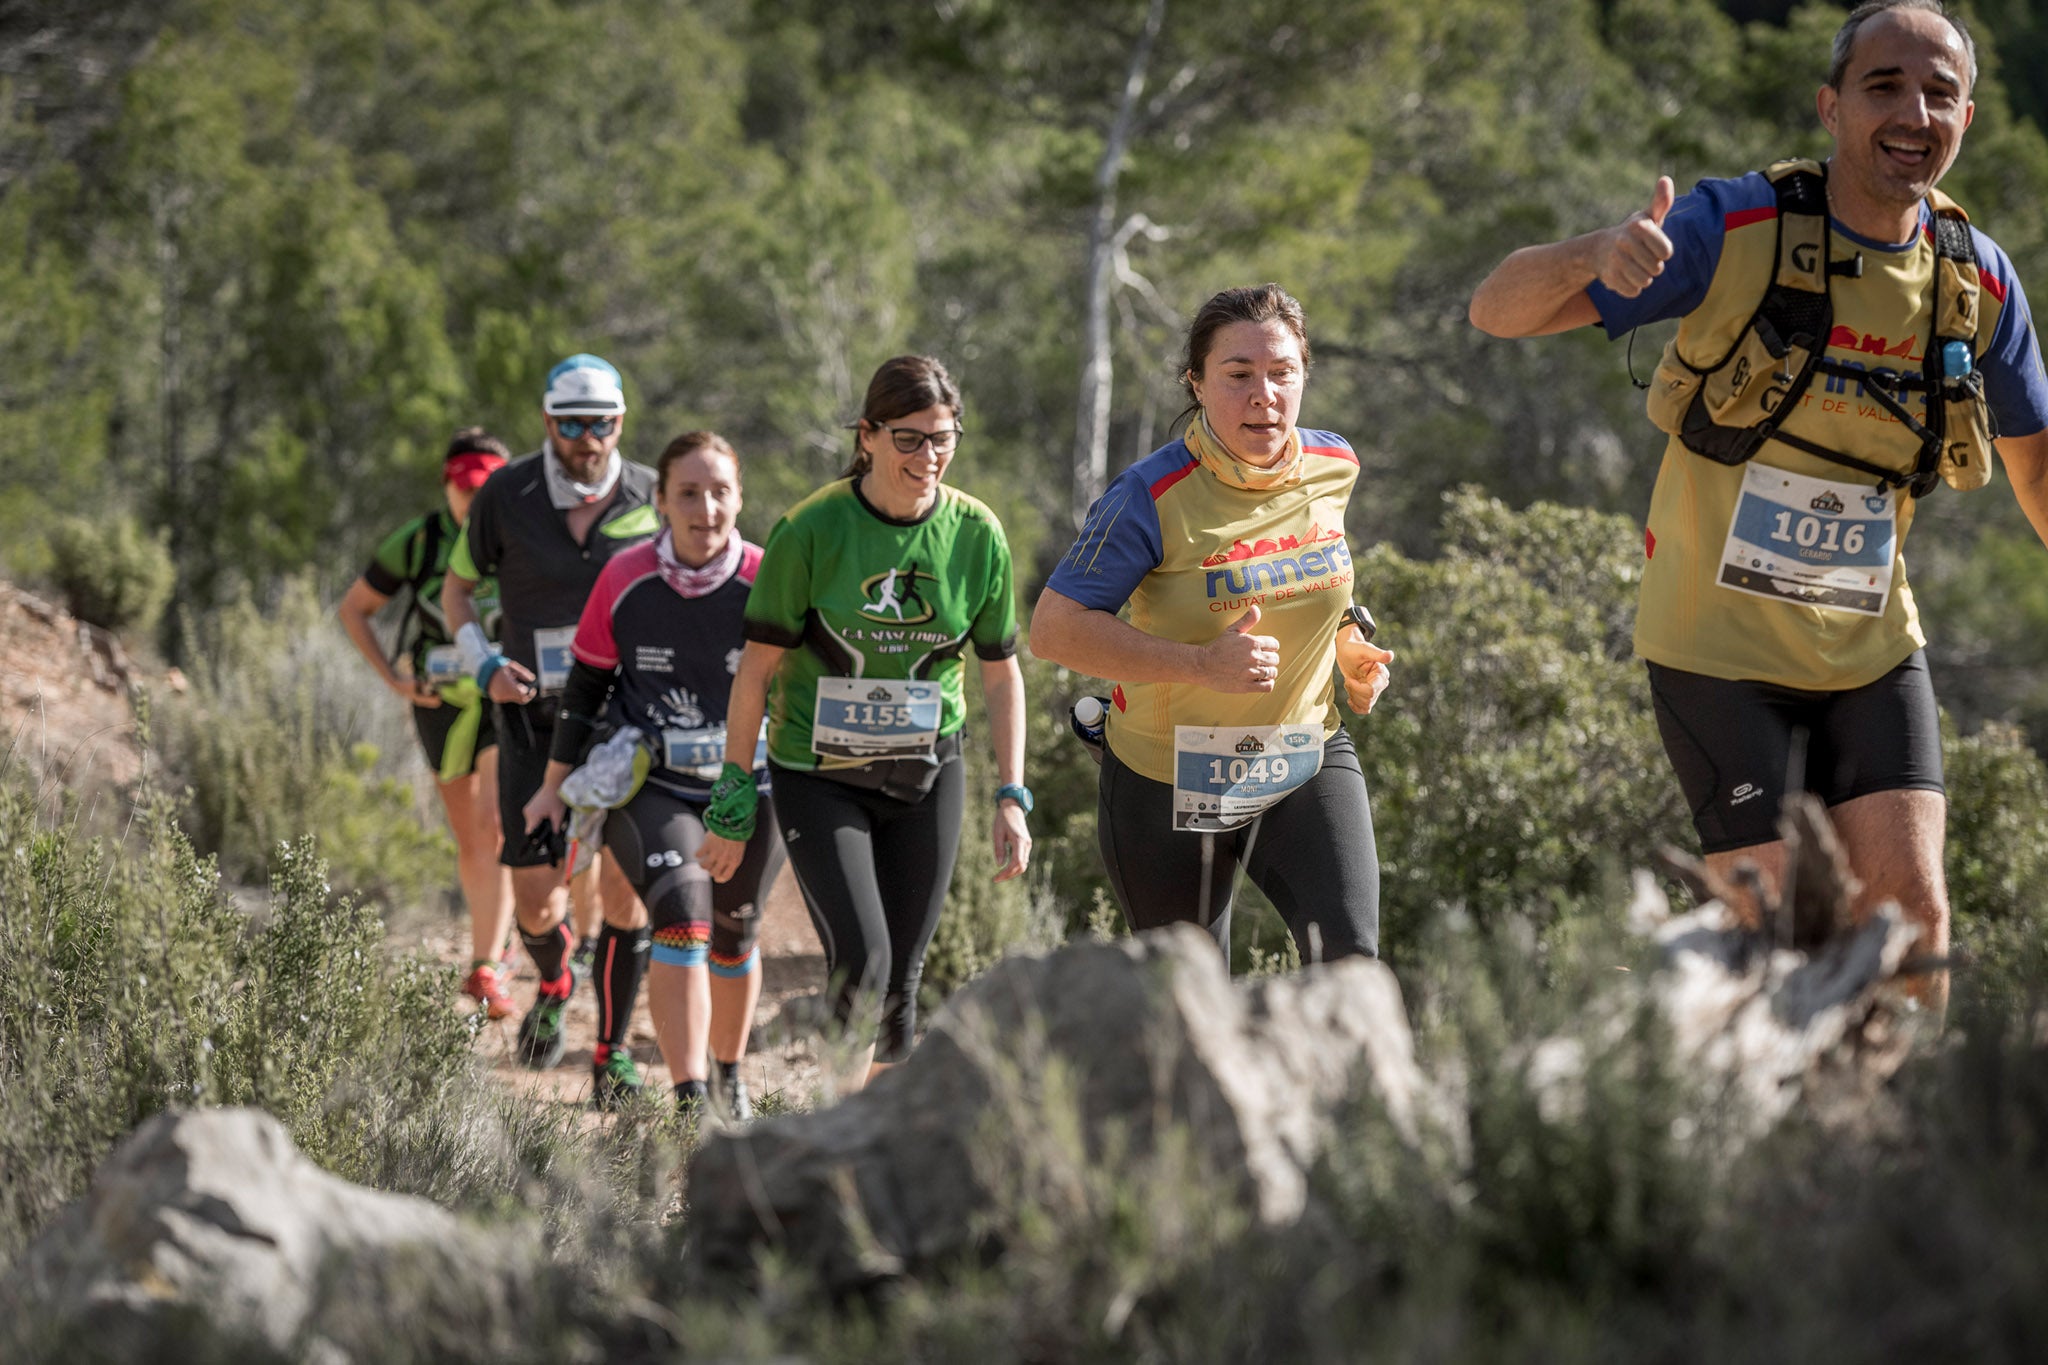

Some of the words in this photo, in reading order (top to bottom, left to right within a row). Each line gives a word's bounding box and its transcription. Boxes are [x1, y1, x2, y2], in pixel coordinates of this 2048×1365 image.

[1821, 399, 1848, 413] DE
[1770, 511, 1866, 555] 1016
[1205, 539, 1352, 598] runners
[1208, 593, 1268, 613] CIUTAT
[1275, 587, 1297, 601] DE
[843, 703, 913, 728] 1155
[1237, 742, 1264, 752] TRAIL
[1288, 735, 1305, 744] 15K
[1208, 757, 1290, 785] 1049
